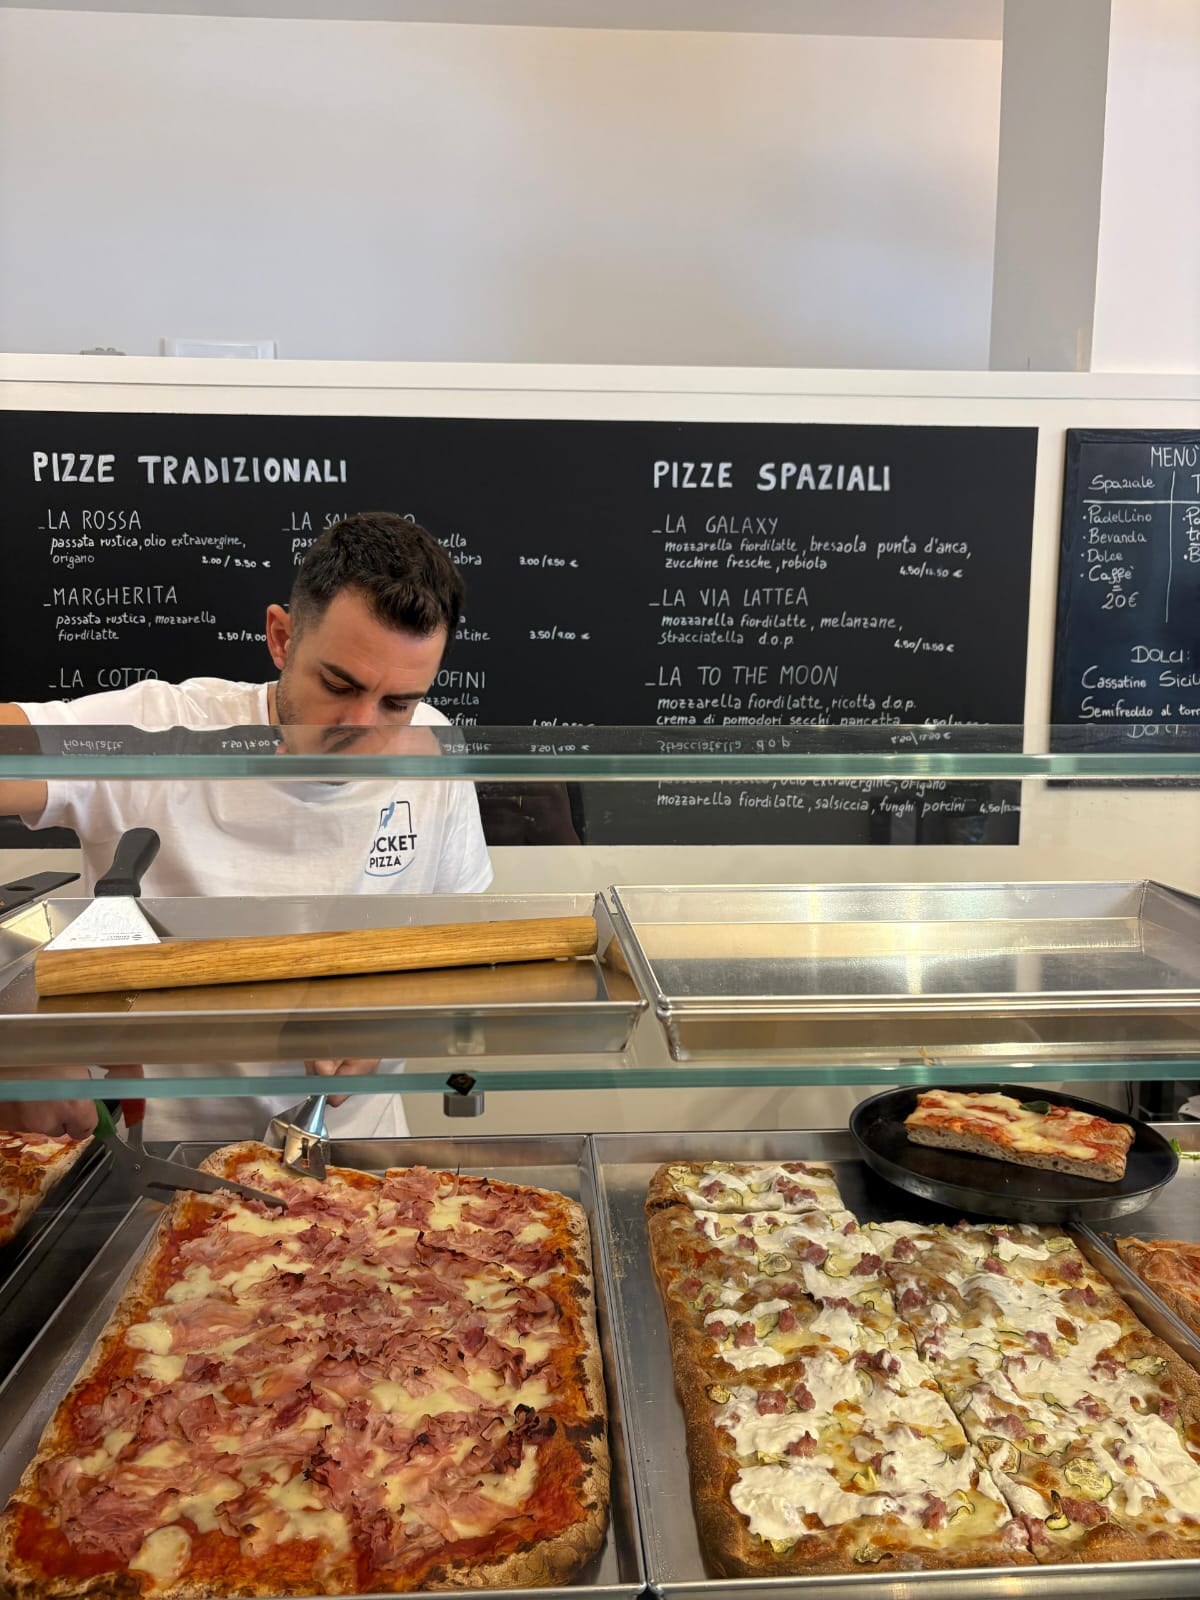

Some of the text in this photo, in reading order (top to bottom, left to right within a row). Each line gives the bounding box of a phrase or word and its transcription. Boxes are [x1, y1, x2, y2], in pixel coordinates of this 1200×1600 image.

[32, 451, 348, 485] PIZZE TRADIZIONALI
[653, 460, 891, 492] PIZZE SPAZIALI
[1088, 474, 1156, 494] Spaziale
[82, 510, 142, 531] ROSSA
[1088, 504, 1152, 525] Padellino
[705, 515, 779, 536] GALAXY
[50, 534, 95, 555] passata
[144, 532, 166, 547] olio
[171, 531, 246, 550] extravergine,
[1088, 528, 1148, 545] Bevanda
[664, 538, 733, 552] mozzarella
[809, 535, 867, 554] bresaola
[876, 535, 917, 559] punta
[923, 537, 972, 560] d'anca,
[1087, 549, 1124, 563] Dolce
[52, 553, 95, 569] origano
[664, 556, 719, 570] zucchine
[781, 556, 828, 571] robiola
[1088, 564, 1135, 584] Caffè
[699, 588, 731, 607] VIA
[743, 586, 809, 607] LATTEA
[55, 612, 102, 629] passata
[154, 611, 216, 625] mozzarella
[661, 613, 734, 627] mozzarella
[58, 628, 120, 642] fiordilatte
[657, 630, 744, 645] stracciatella
[696, 666, 721, 686] TO
[732, 665, 769, 686] THE
[779, 664, 839, 688] MOON
[656, 694, 742, 711] mozzarella
[831, 693, 875, 710] ricotta
[1078, 696, 1153, 719] Semifreddo
[1160, 704, 1171, 716] al
[656, 714, 696, 726] crema
[703, 713, 716, 725] di
[722, 713, 783, 726] pomodori
[656, 791, 732, 806] mozzarella
[879, 795, 916, 818] funghi
[921, 801, 965, 818] porcini
[369, 855, 401, 868] PIZZA
